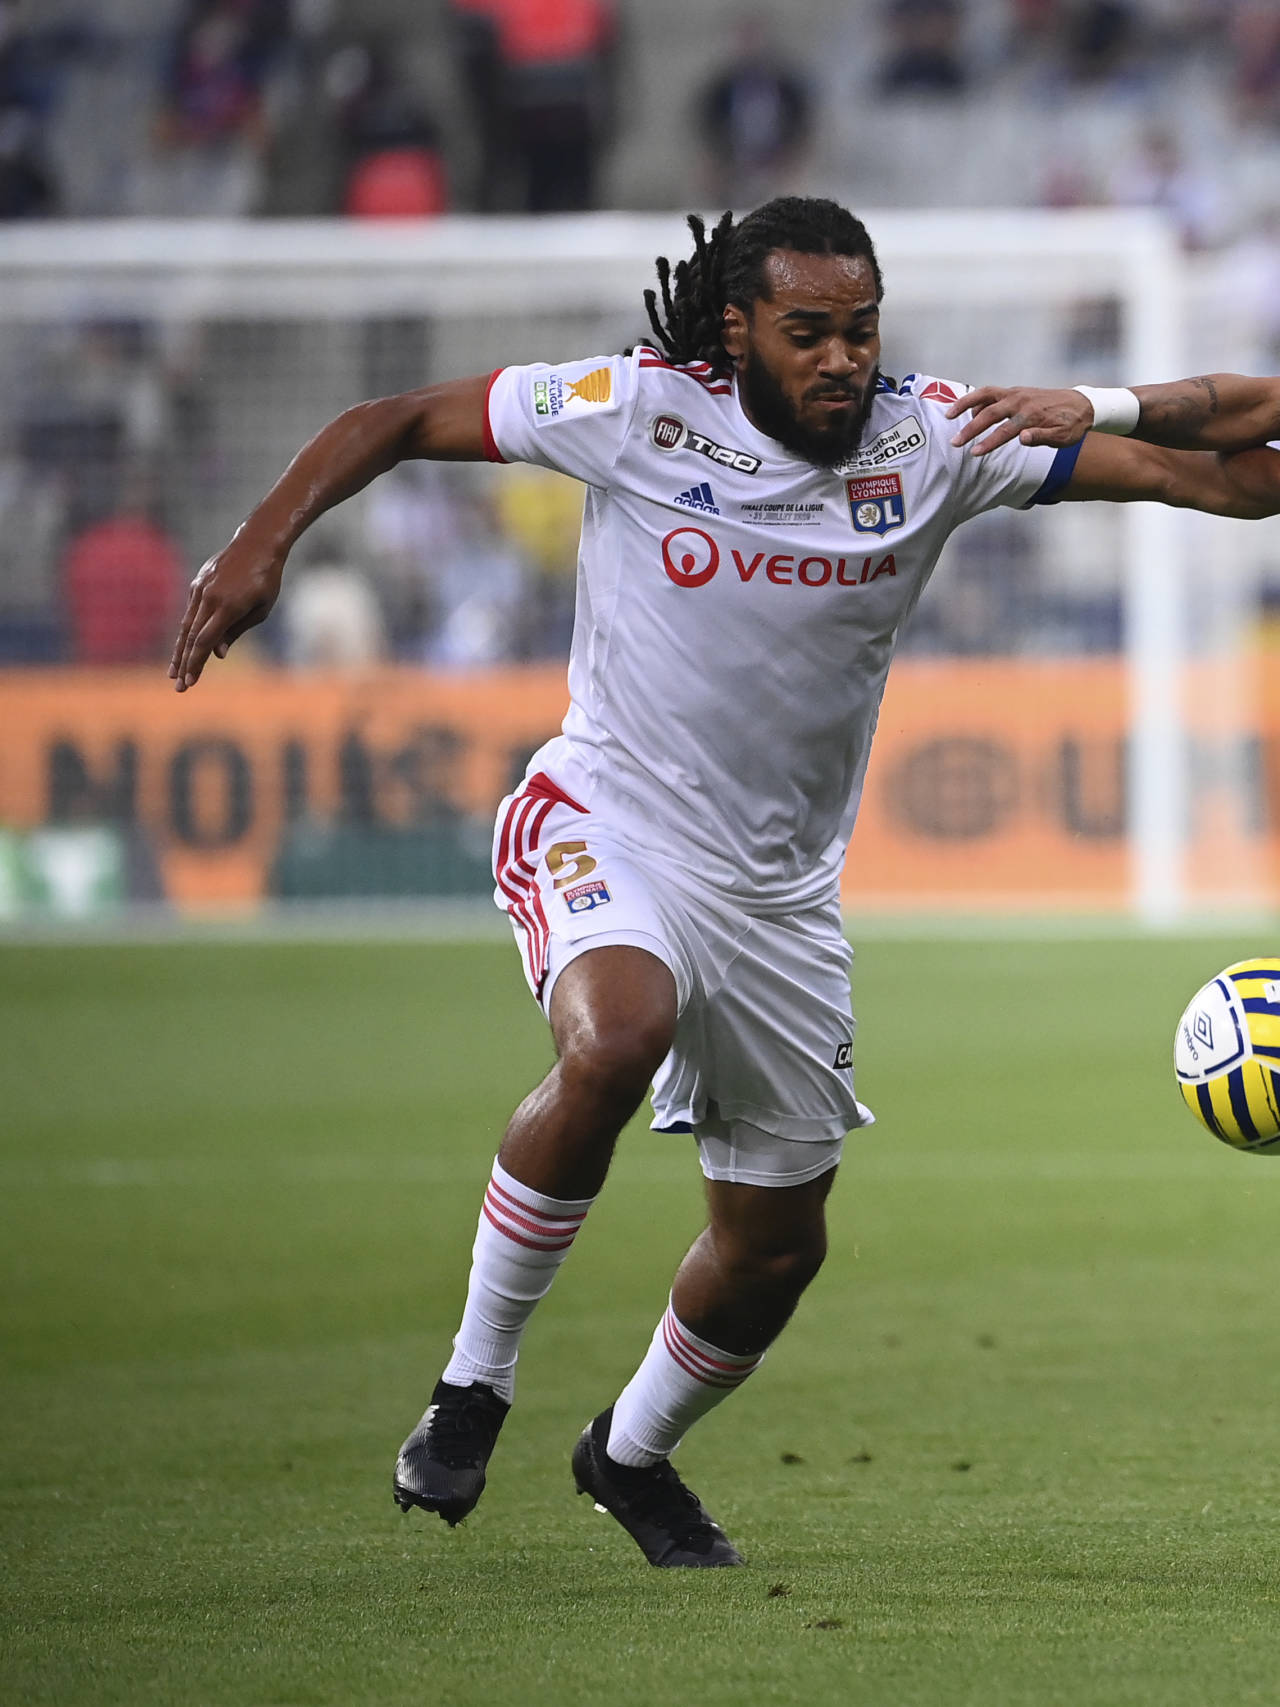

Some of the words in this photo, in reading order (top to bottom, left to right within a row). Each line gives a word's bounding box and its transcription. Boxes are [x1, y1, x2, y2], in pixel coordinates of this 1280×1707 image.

[549, 388, 559, 416] LIGUE
[656, 422, 680, 443] FIAT
[693, 435, 757, 472] TIPO
[851, 478, 897, 492] OLYMPIQUE
[852, 485, 898, 499] LYONNAIS
[673, 496, 720, 515] adidas
[763, 503, 785, 512] COUPE
[785, 503, 795, 512] DE
[795, 503, 804, 512] LA
[805, 503, 824, 512] LIGUE
[731, 550, 897, 587] VEOLIA
[545, 841, 597, 890] 5
